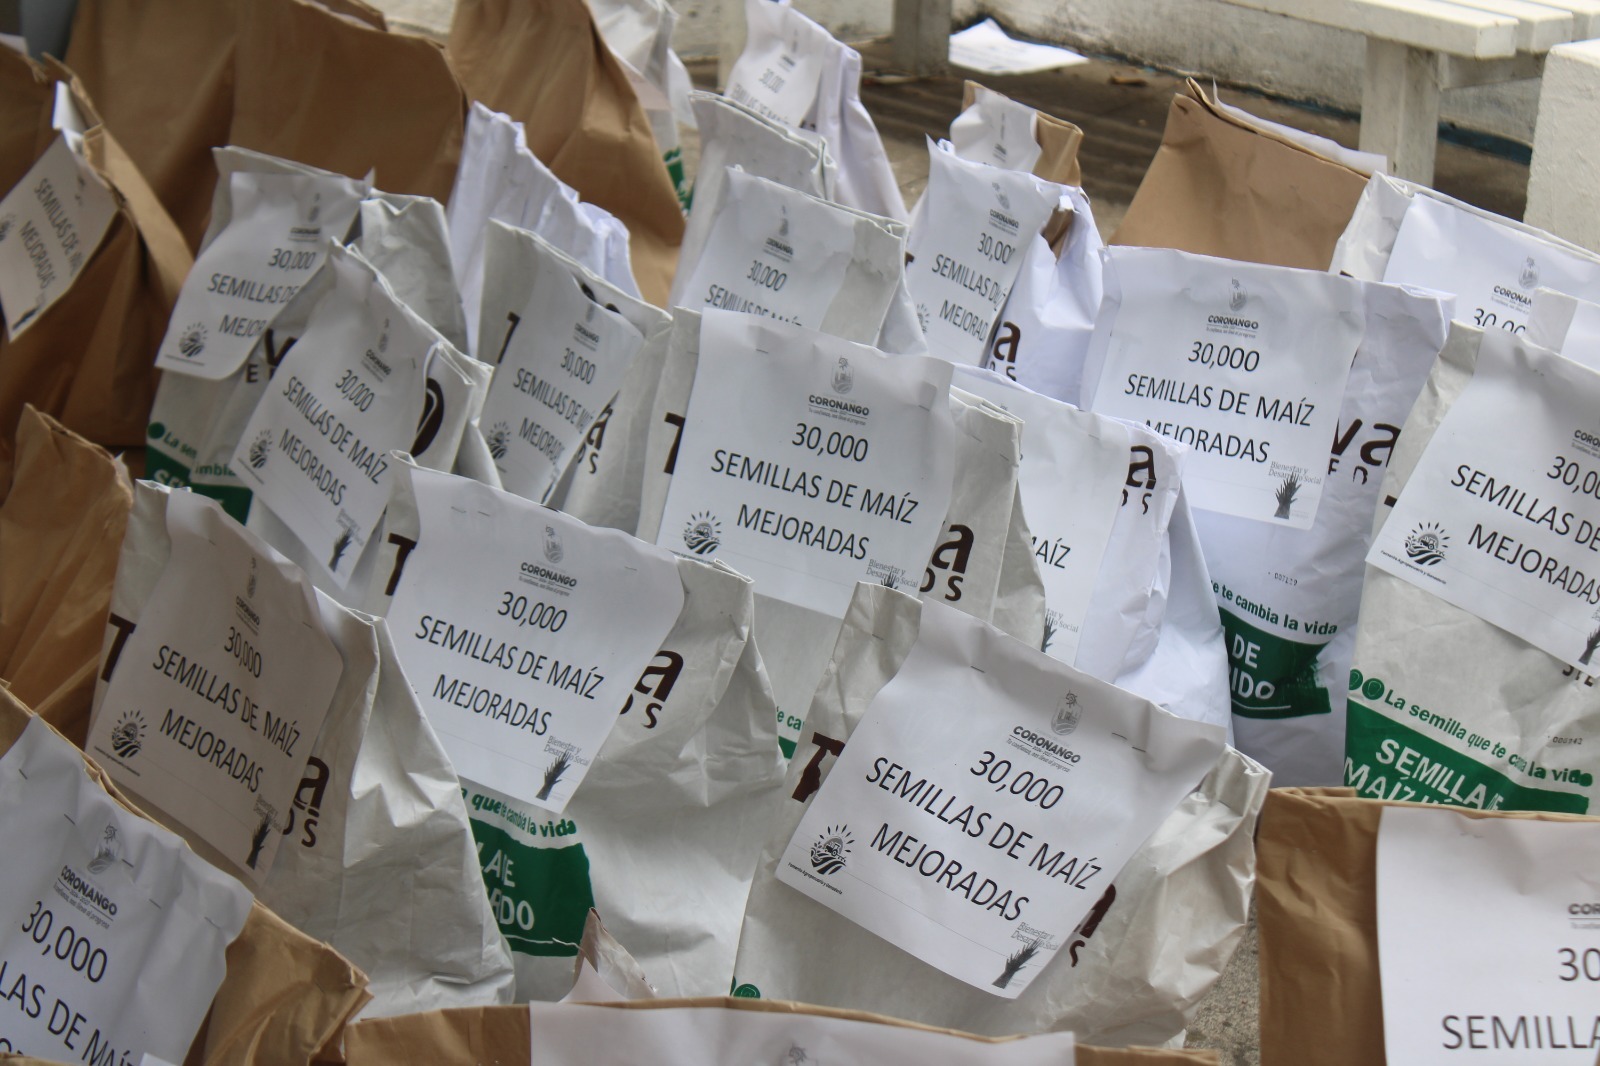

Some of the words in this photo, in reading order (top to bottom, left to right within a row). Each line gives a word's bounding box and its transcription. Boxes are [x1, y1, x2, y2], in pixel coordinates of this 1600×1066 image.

[34, 177, 71, 239] SEMILLAS
[268, 248, 315, 270] 30,000
[746, 260, 788, 292] 30,000
[932, 253, 990, 298] SEMILLAS
[207, 273, 281, 304] SEMILLAS
[218, 314, 267, 338] MEJOR
[1208, 314, 1259, 330] CORONANGO
[560, 347, 596, 385] 30,000
[1188, 341, 1261, 372] 30,000
[335, 369, 375, 413] 30,000
[513, 367, 567, 416] SEMILLAS
[565, 397, 582, 425] DE
[808, 394, 870, 416] CORONANGO
[1124, 373, 1214, 408] SEMILLAS
[1218, 389, 1250, 416] DE
[1255, 395, 1315, 427] MAÍZ
[283, 376, 334, 436] SEMILLAS
[330, 422, 352, 454] DE
[348, 440, 388, 485] MAÍZ
[792, 422, 869, 462] 30,000
[279, 428, 347, 506] MEJORADAS
[711, 449, 822, 499] SEMILLAS
[825, 480, 858, 508] DE
[860, 489, 919, 524] MAÍZ
[736, 504, 870, 560] MEJORADAS
[1451, 464, 1575, 536] SEMILLAS
[1574, 519, 1600, 552] DE
[520, 562, 577, 587] CORONANGO
[1031, 537, 1071, 569] AÍZ
[1468, 523, 1600, 605] MEJORADAS
[900, 577, 919, 588] Social
[497, 591, 568, 633] 30,000
[1058, 621, 1079, 633] Social
[1221, 584, 1233, 600] te
[1235, 594, 1279, 625] cambia
[1283, 613, 1299, 631] la
[1303, 620, 1338, 635] vida
[224, 626, 262, 679] 30,000
[415, 615, 518, 671] SEMILLAS
[517, 651, 548, 681] DE
[547, 667, 605, 700] MAÍZ
[1232, 633, 1261, 669] DE
[153, 645, 241, 715] SEMILLAS
[240, 696, 259, 731] DE
[263, 711, 300, 758] MAÍZ
[432, 674, 552, 736] MEJORADAS
[159, 708, 264, 793] MEJORADAS
[1013, 726, 1081, 763] CORONANGO
[1384, 689, 1406, 711] La
[1408, 703, 1467, 741] semilla
[1467, 733, 1491, 752] que
[1494, 741, 1506, 759] te
[1528, 761, 1547, 779] la
[970, 750, 1064, 809] 30,000
[471, 793, 501, 813] que
[526, 817, 537, 836] la
[539, 818, 577, 838] vida
[866, 756, 991, 838] SEMILLAS
[989, 822, 1033, 860] DE
[1028, 842, 1102, 890] MAÍZ
[61, 864, 117, 916] CORONANGO
[870, 822, 1030, 921] MEJORADAS
[22, 901, 108, 983] 30,000
[47, 998, 87, 1051] DE
[1442, 1015, 1600, 1049] SEMILLA
